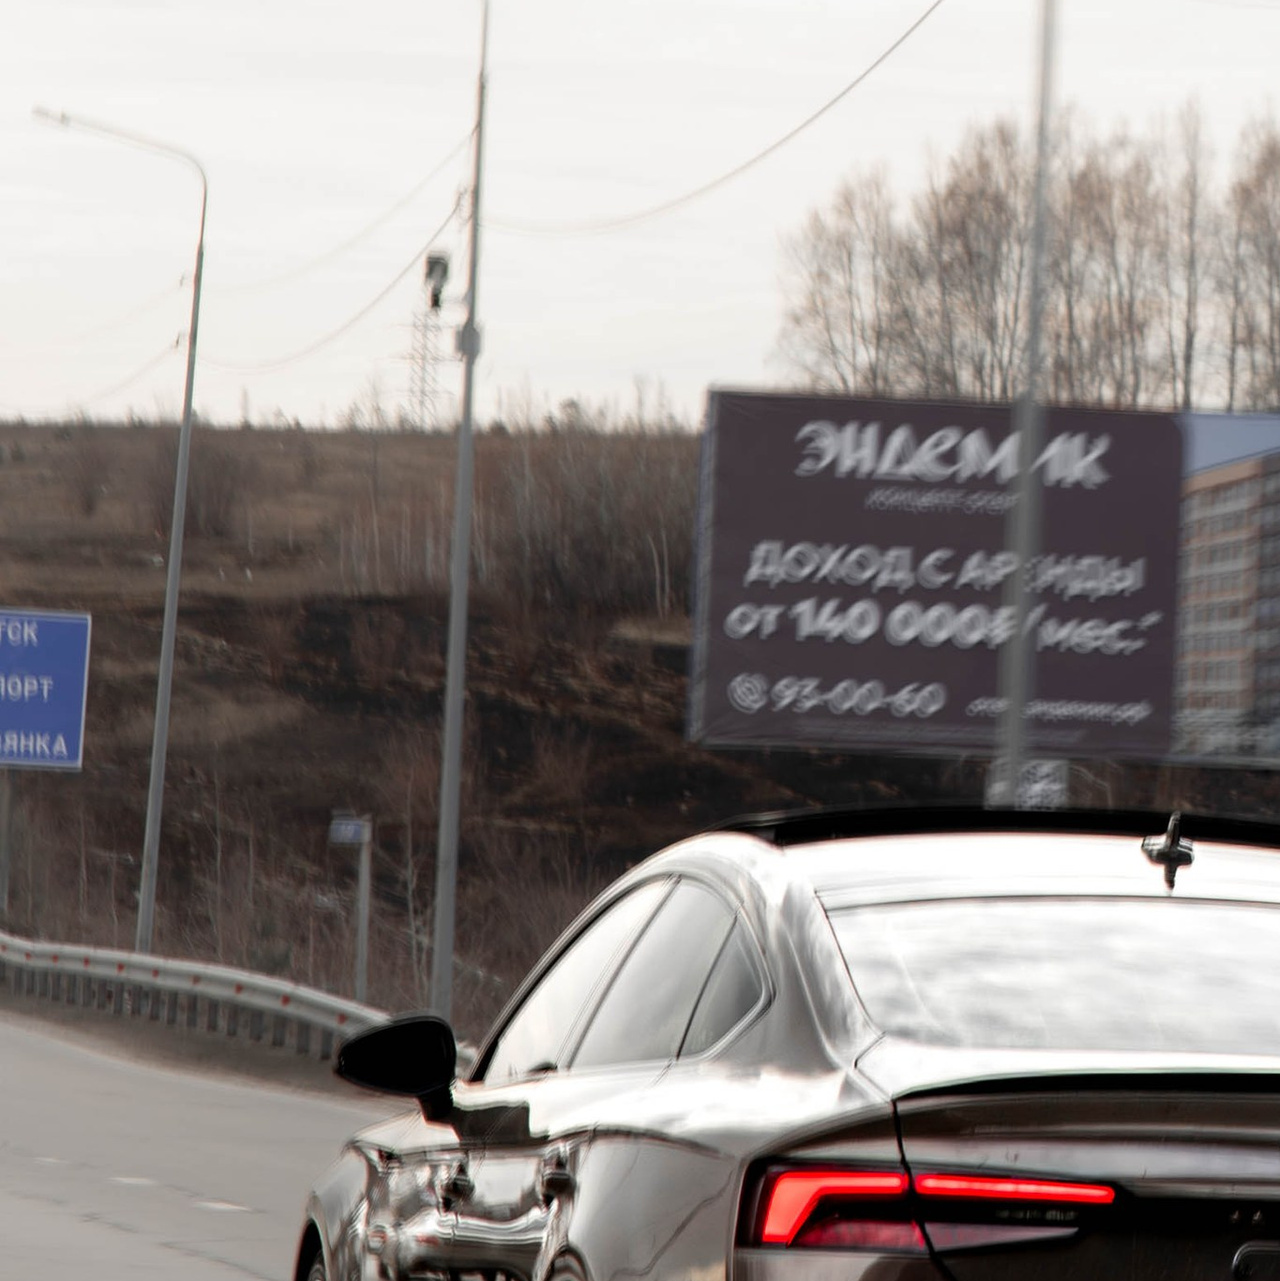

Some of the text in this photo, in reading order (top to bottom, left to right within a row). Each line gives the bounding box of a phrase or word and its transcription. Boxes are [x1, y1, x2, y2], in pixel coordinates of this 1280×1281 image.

[743, 539, 915, 594] ДОХОД
[917, 548, 955, 589] С
[790, 596, 880, 645] 140
[771, 675, 947, 718] 93-00-60
[0, 731, 68, 759] ЯНКА
